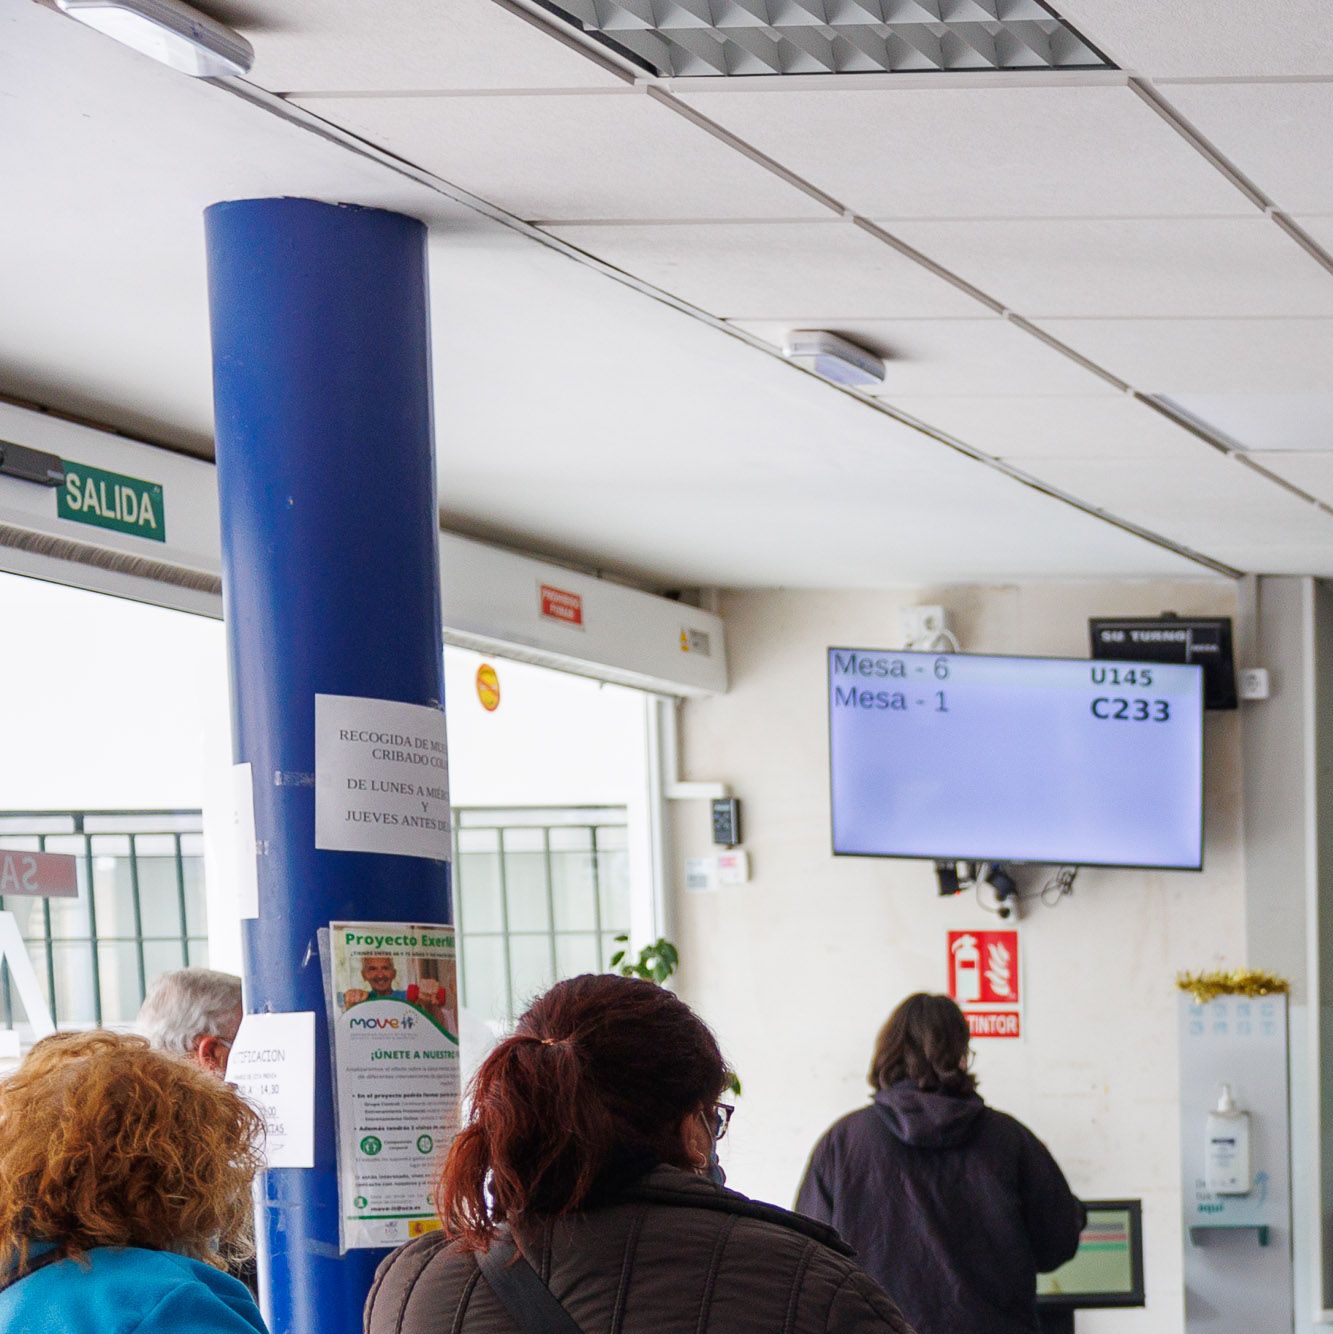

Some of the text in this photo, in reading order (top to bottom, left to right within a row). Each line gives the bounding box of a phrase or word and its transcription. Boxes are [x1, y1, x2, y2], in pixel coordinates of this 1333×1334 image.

[66, 472, 157, 529] SALIDA
[834, 653, 907, 678] Mesa
[934, 657, 949, 680] 6
[1091, 667, 1152, 686] U145
[835, 686, 907, 711] Mesa
[936, 691, 949, 712] 1
[1092, 698, 1170, 721] C233
[340, 729, 412, 748] RECOGIDA
[414, 738, 428, 750] DE
[372, 748, 428, 764] CRIBADO
[347, 778, 367, 790] DE
[371, 780, 414, 796] LUNES
[416, 786, 425, 797] A
[421, 801, 429, 812] Y
[345, 810, 398, 826] JUEVES
[401, 815, 436, 830] ANTES
[345, 933, 418, 949] Proyecto
[966, 1014, 1018, 1034] TINTOR
[371, 1048, 410, 1061] ¡ÚNETE
[413, 1051, 421, 1059] A
